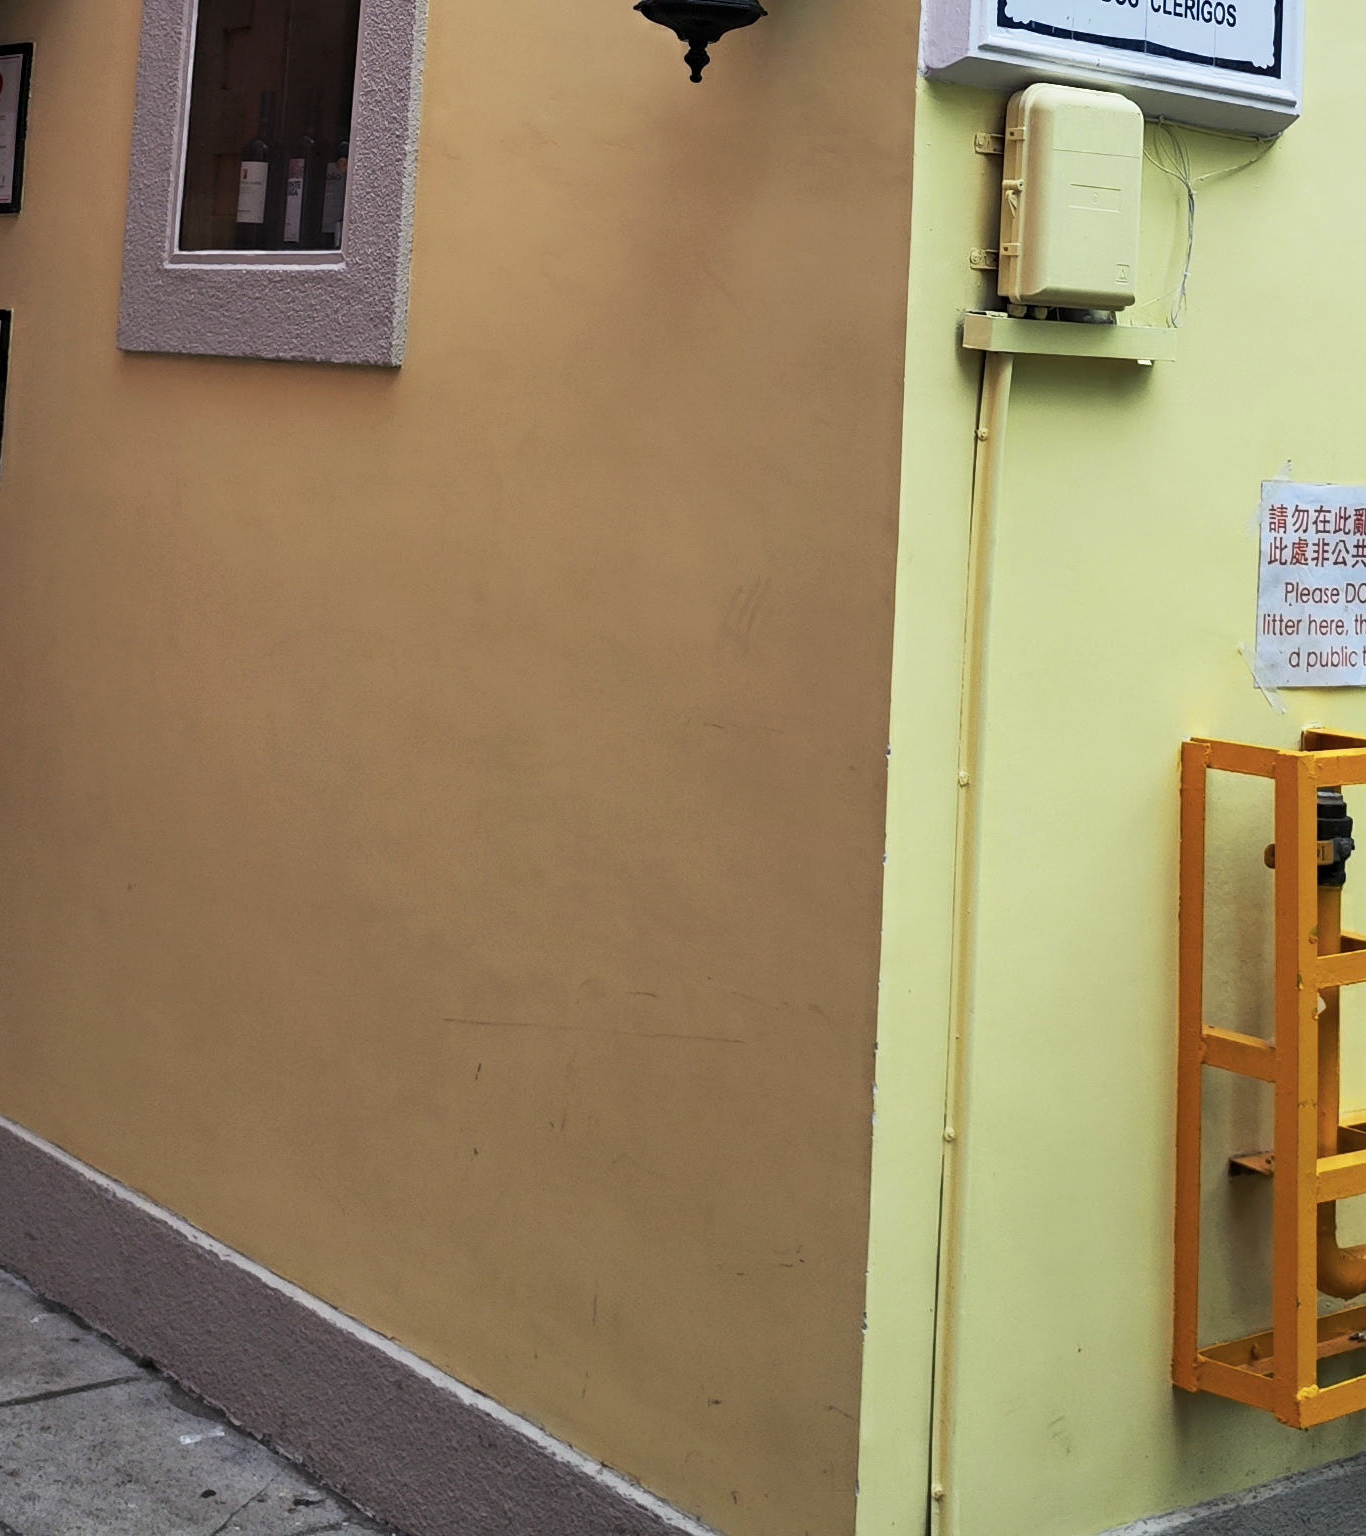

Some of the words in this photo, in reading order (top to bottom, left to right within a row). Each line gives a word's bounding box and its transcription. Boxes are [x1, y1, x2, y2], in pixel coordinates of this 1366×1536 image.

[1284, 582, 1340, 604] Please
[1262, 614, 1302, 636] litter
[1307, 614, 1349, 637] here,
[1306, 646, 1359, 672] public
